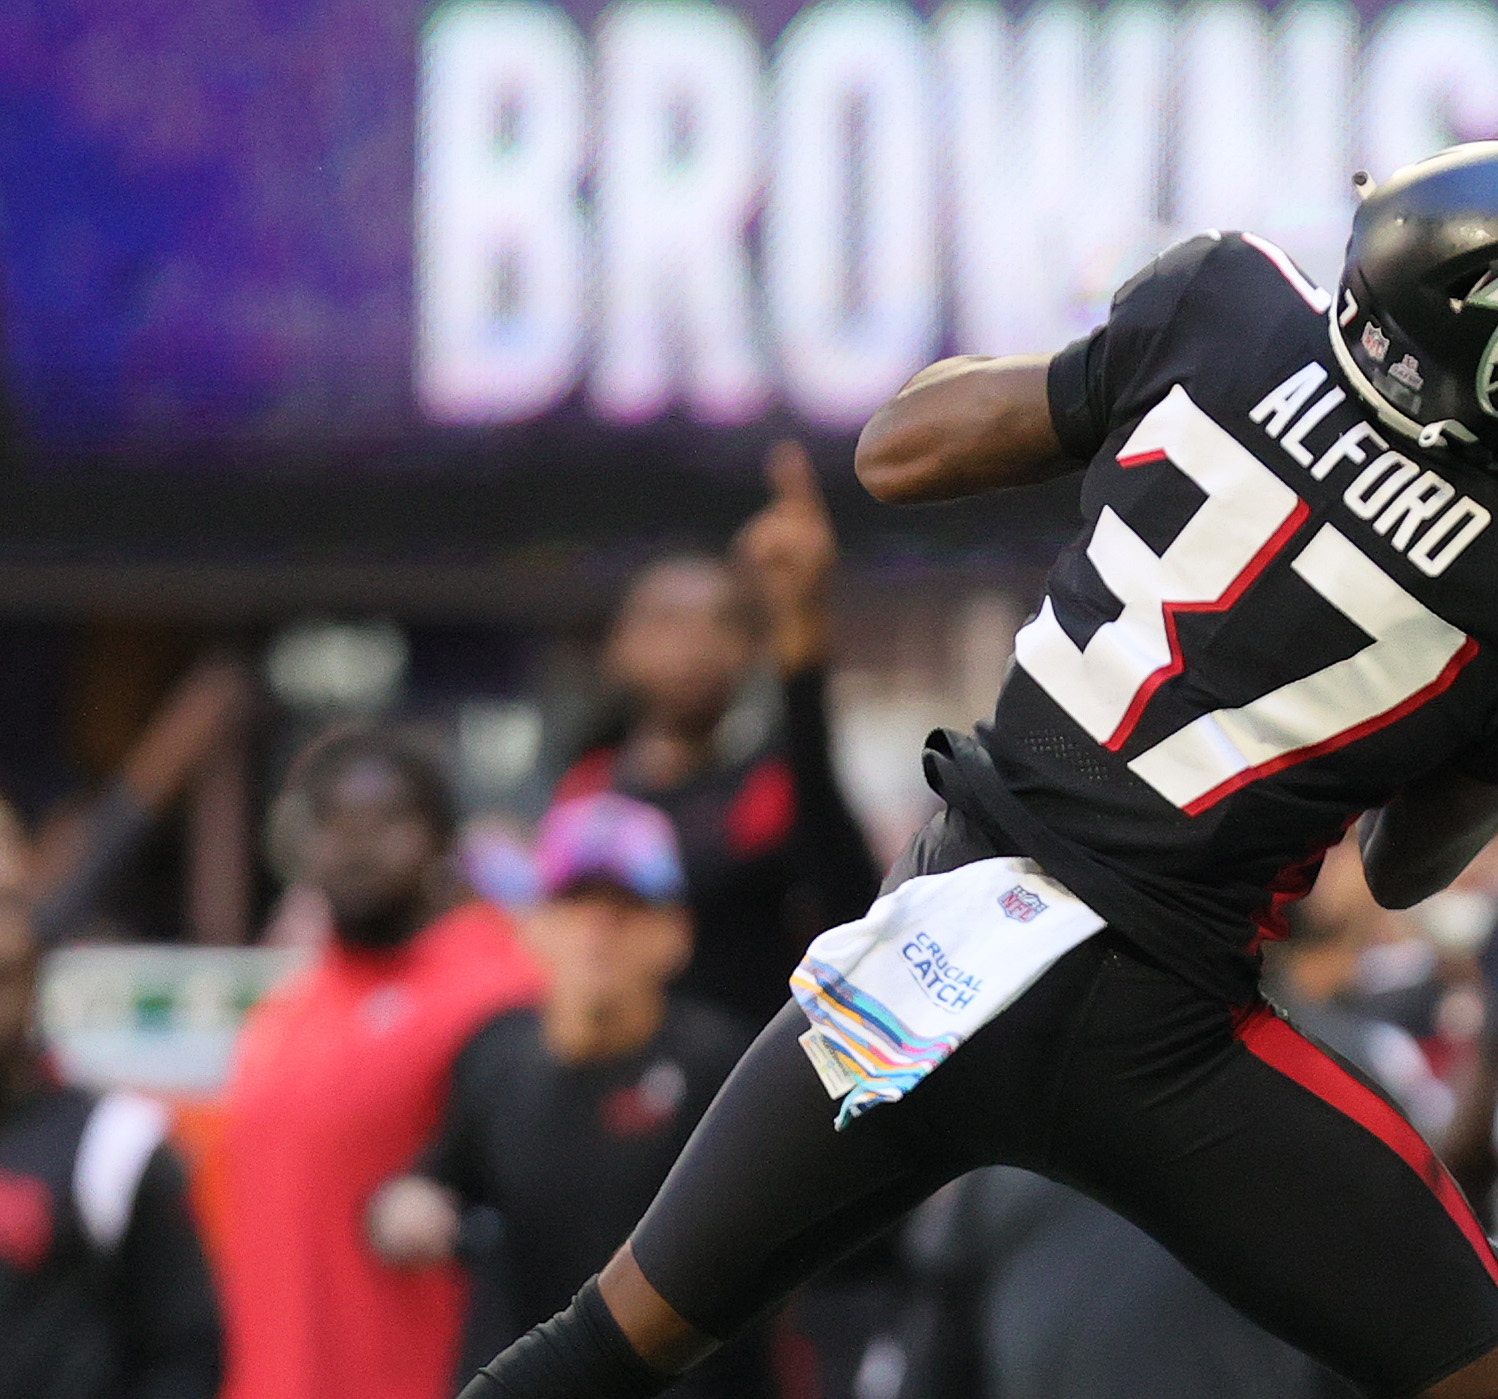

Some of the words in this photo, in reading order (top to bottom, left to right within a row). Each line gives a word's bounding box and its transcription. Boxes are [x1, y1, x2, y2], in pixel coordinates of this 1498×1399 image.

[1248, 360, 1492, 578] ALFORD
[1014, 383, 1481, 818] 37
[902, 941, 976, 1010] CATCH
[915, 931, 984, 992] CRUCIAL
